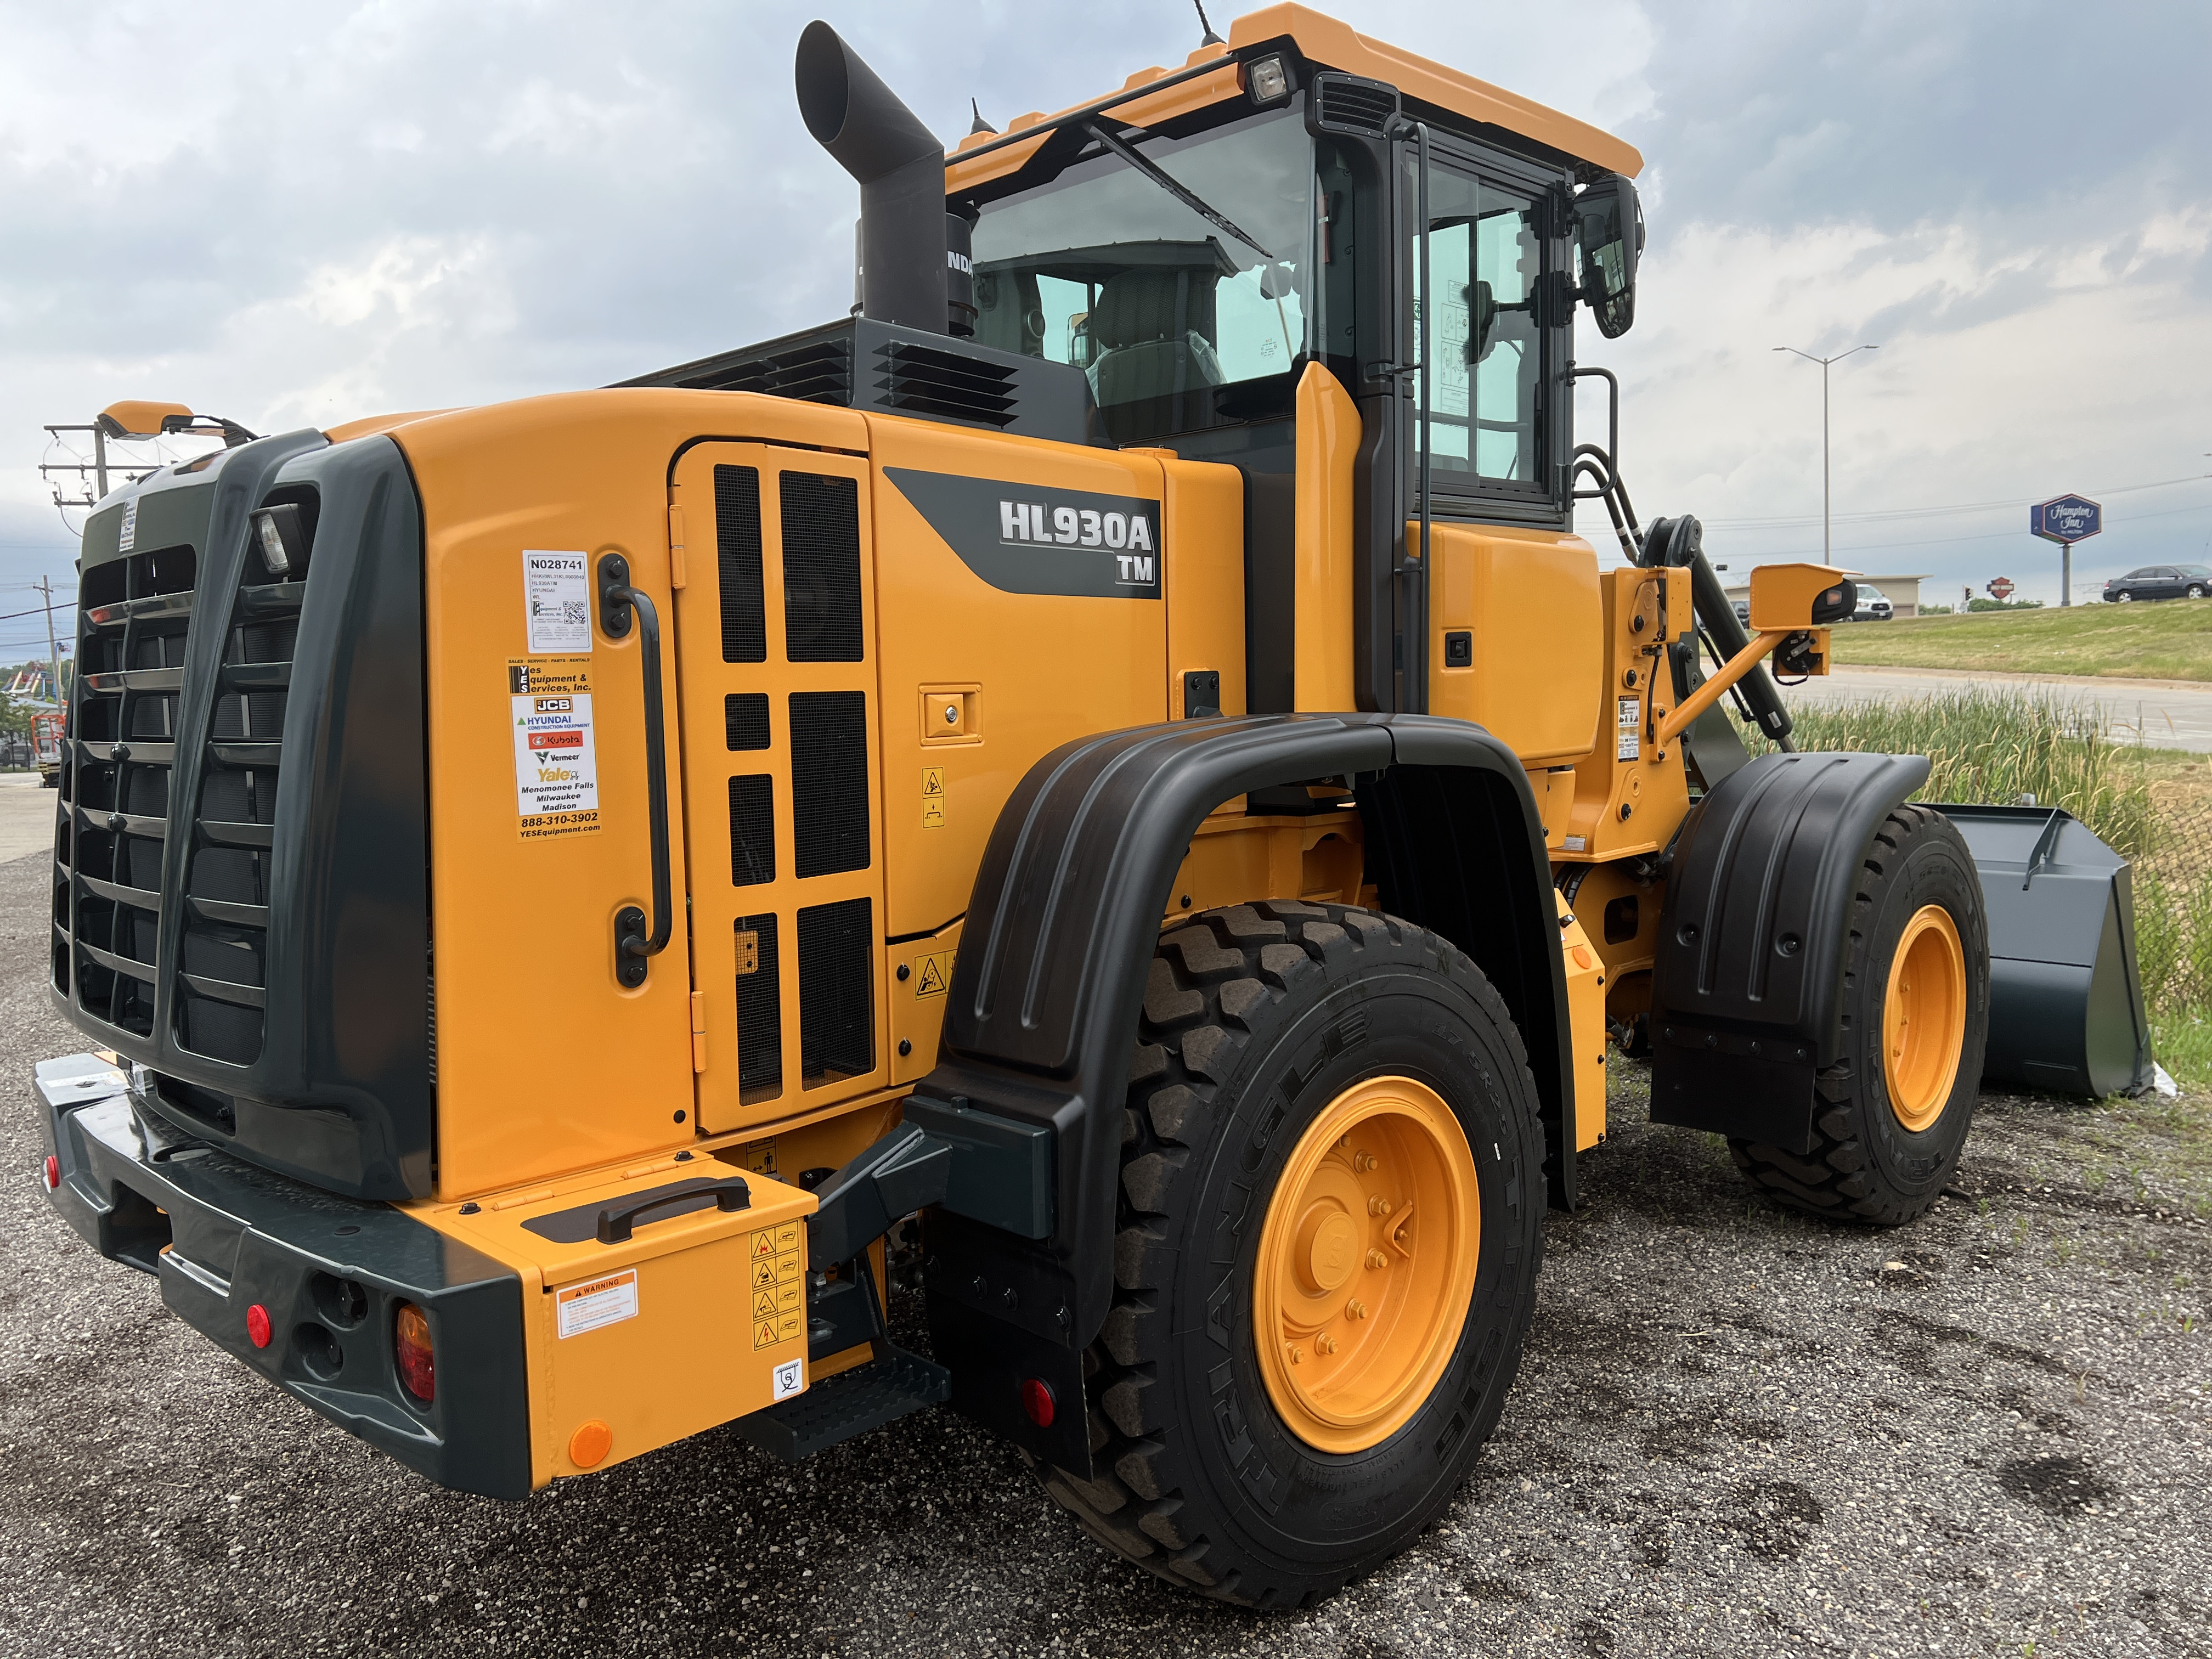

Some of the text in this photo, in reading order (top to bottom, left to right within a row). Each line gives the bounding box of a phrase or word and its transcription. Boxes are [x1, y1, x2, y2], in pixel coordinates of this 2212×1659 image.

[2050, 504, 2094, 520] Hampton
[1000, 500, 1153, 551] HL930A
[2060, 516, 2084, 529] Inn
[531, 559, 582, 569] N028741
[1116, 555, 1153, 582] TM
[538, 699, 570, 710] JCB
[527, 716, 571, 725] HYUNDAI
[547, 735, 580, 744] Kubota
[537, 768, 570, 782] Yale
[521, 785, 572, 794] Menomonee
[536, 793, 582, 803] Milwaukee
[521, 812, 598, 828] 888-310-3902
[520, 825, 601, 838] YESEquipment.com
[1206, 1008, 1367, 1516] TRIANGLE
[583, 1278, 619, 1294] WARNING
